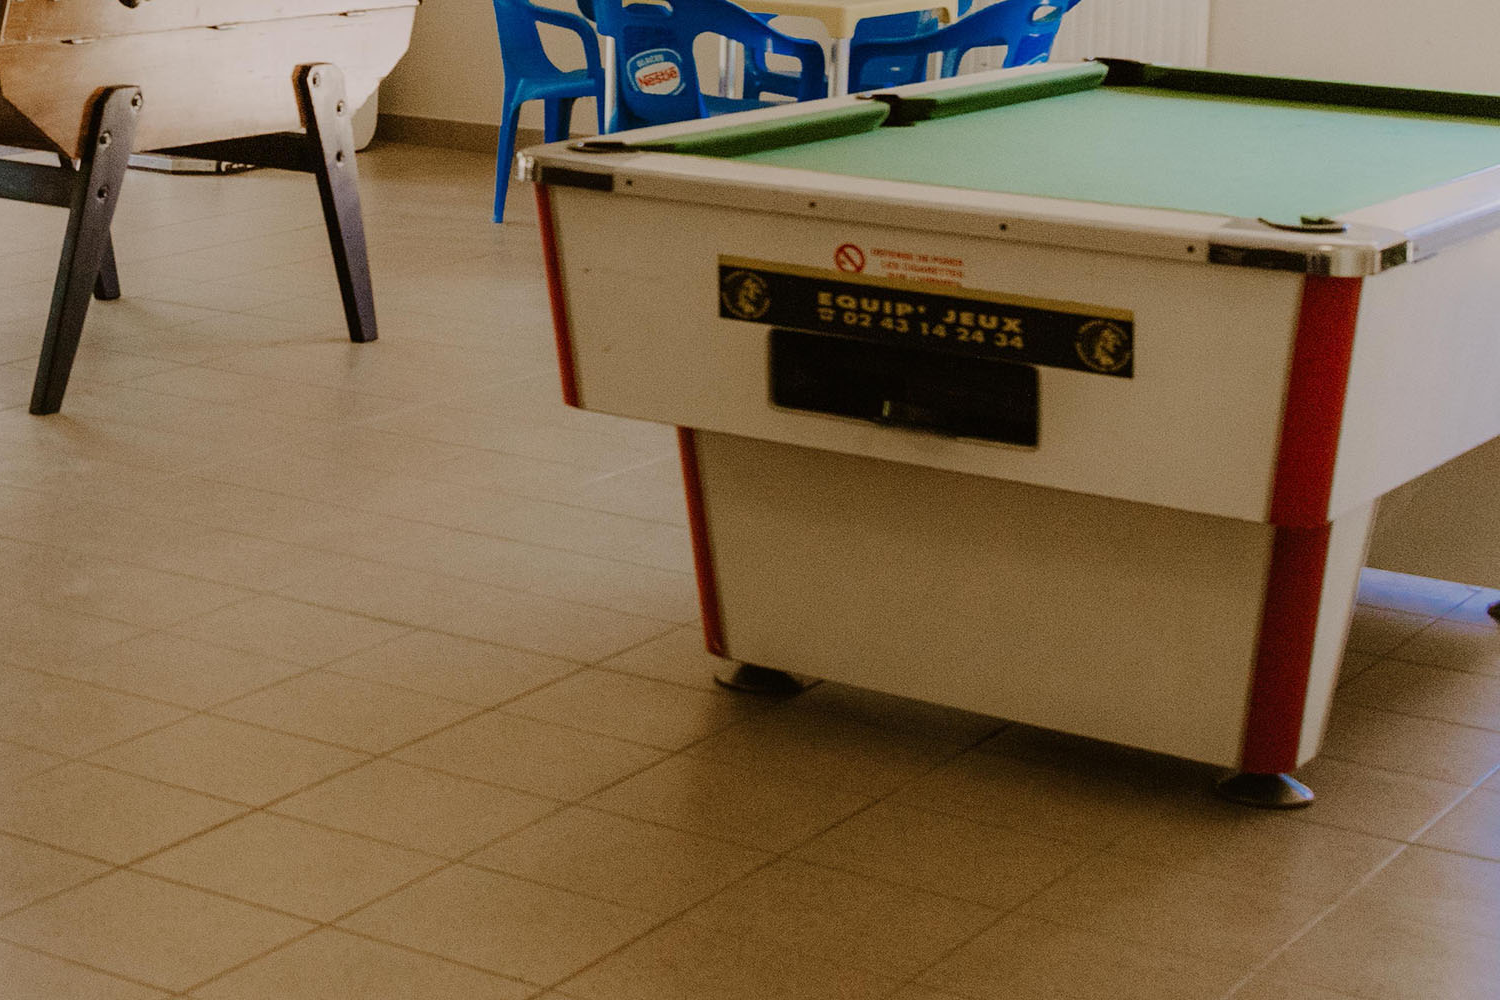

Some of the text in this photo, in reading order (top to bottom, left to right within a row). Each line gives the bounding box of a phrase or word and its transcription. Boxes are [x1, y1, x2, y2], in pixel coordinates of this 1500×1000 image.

[842, 310, 873, 328] 02
[920, 321, 948, 339] 14
[956, 326, 986, 344] 24
[994, 331, 1025, 350] 34
[941, 309, 1023, 334] JEUX
